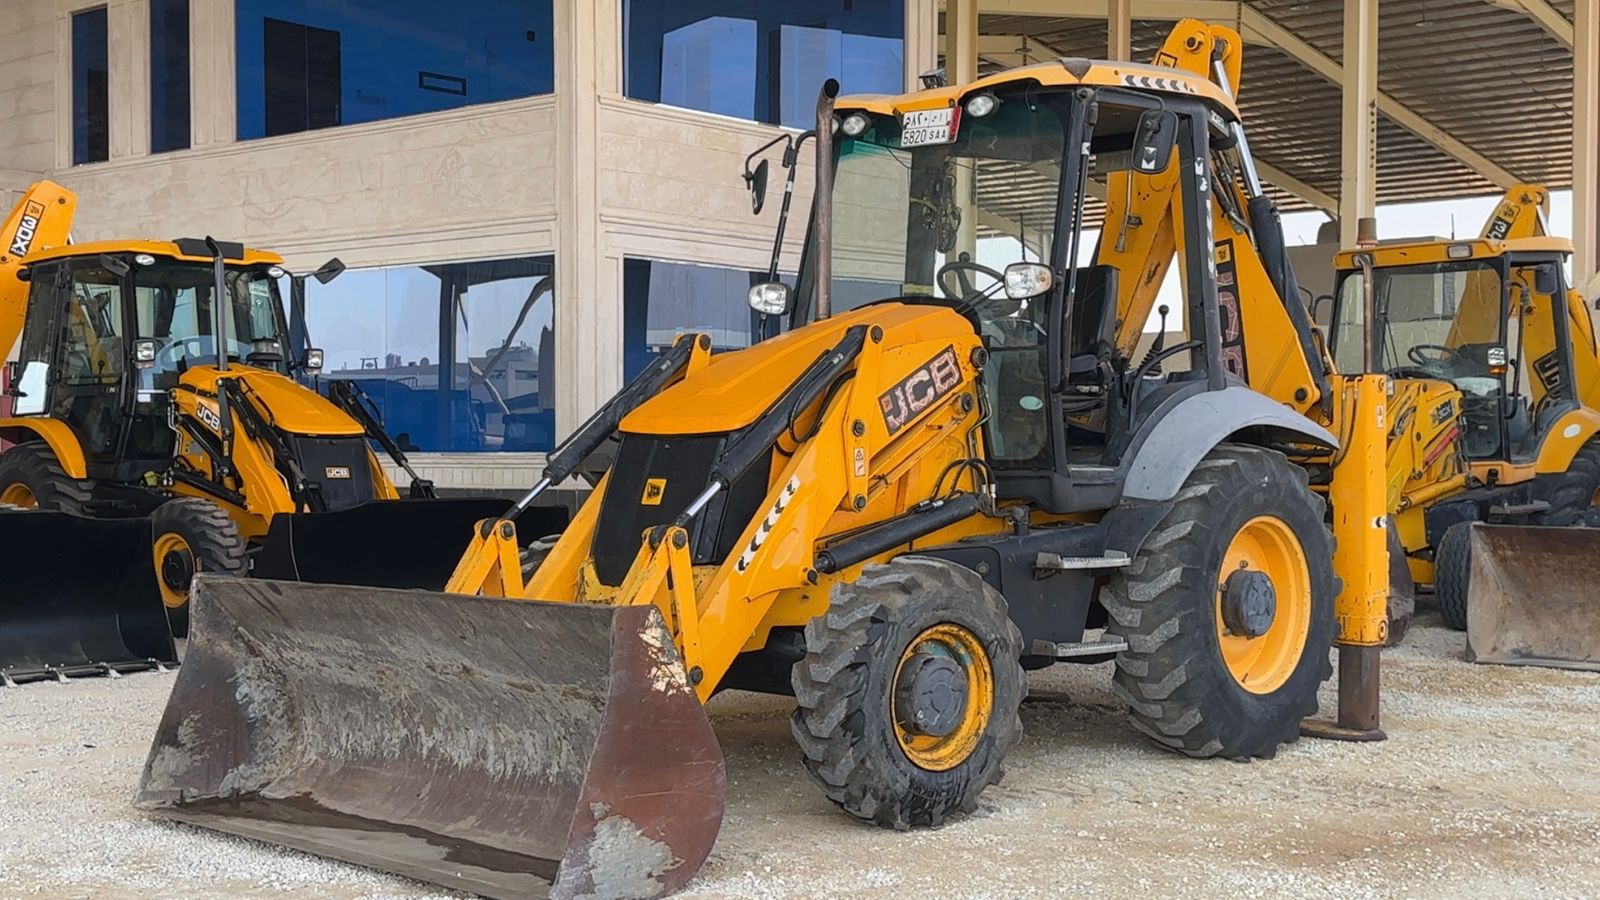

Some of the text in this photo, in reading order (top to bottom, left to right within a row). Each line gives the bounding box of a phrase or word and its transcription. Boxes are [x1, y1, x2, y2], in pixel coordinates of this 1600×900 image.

[903, 129, 946, 146] 5820 SAA
[886, 348, 960, 430] JCB
[197, 406, 220, 432] JCB
